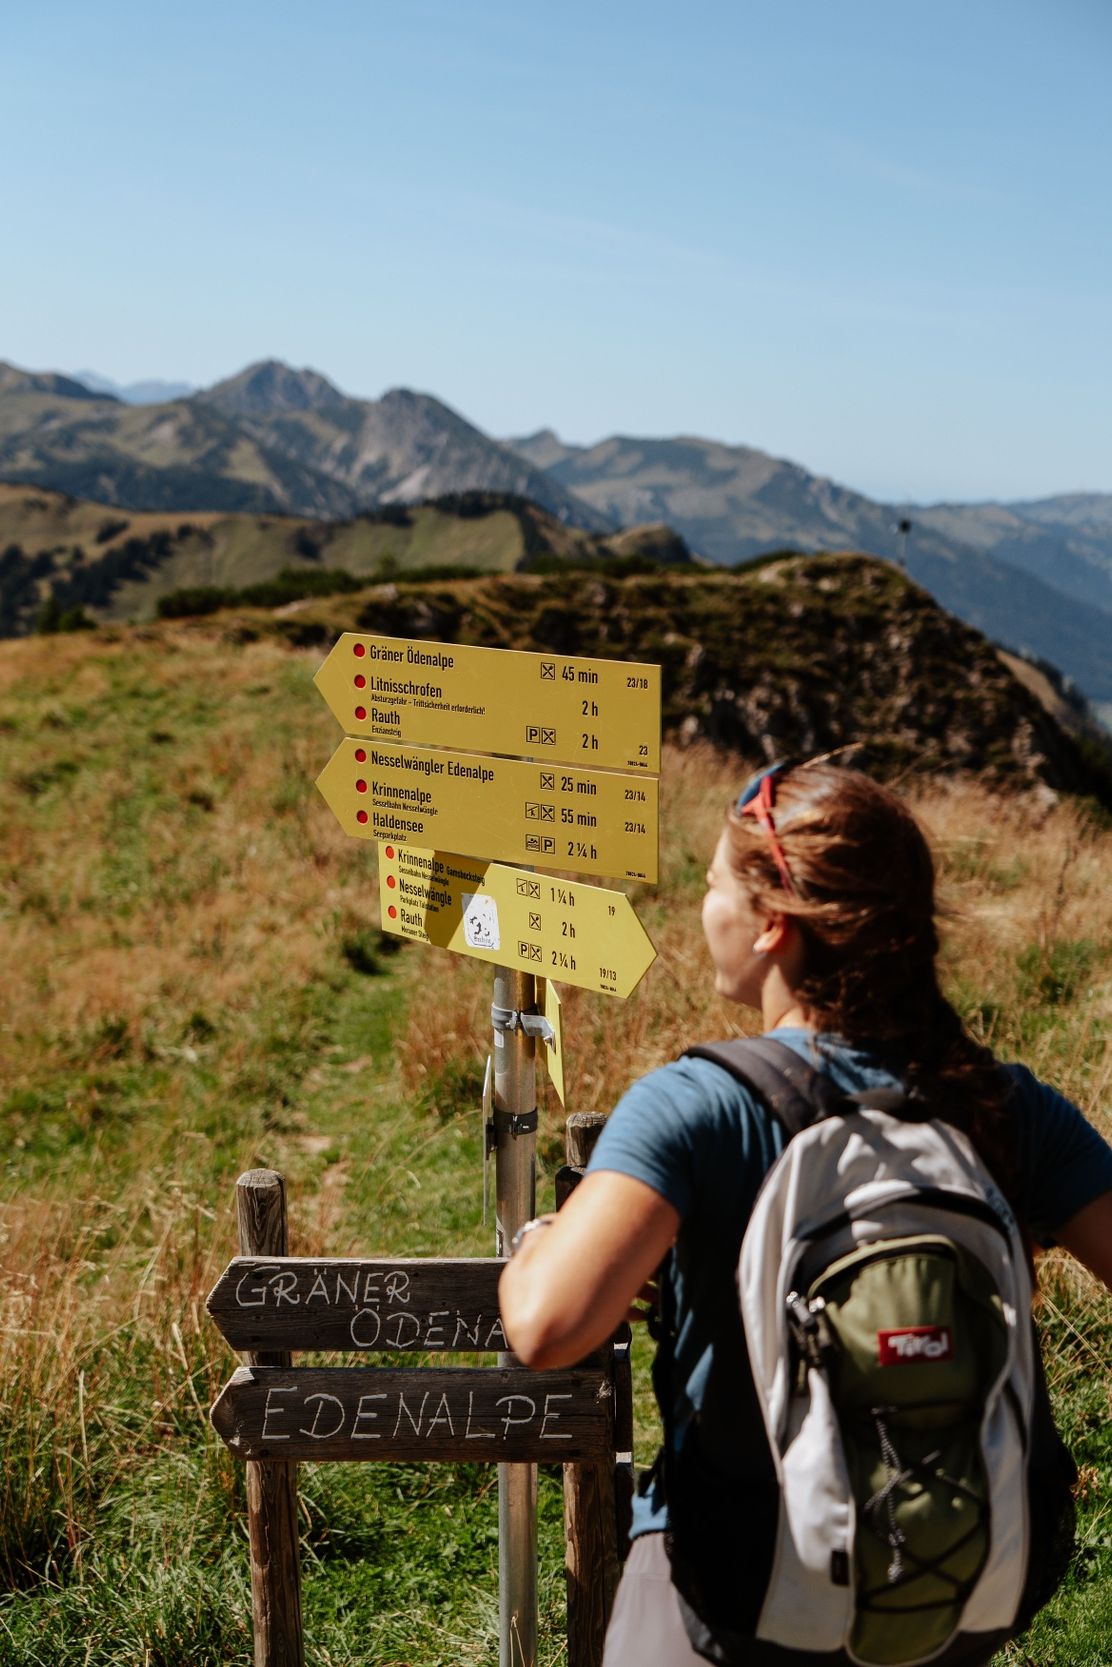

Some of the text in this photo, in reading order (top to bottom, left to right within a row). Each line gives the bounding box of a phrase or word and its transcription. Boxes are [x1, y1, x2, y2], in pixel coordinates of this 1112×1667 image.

[370, 645, 454, 671] Gräner Ödenalpe
[562, 666, 598, 684] 45 min
[627, 677, 648, 689] 23/18
[371, 676, 442, 698] Litnisschrofen
[371, 707, 400, 725] Rauth
[582, 700, 598, 716] 2 h
[582, 733, 598, 750] 2 h
[639, 745, 648, 756] 23
[371, 750, 494, 783] Nesselwängler Edenalpe
[372, 781, 432, 806] Krinnenalpe
[561, 776, 597, 795] 25 min
[624, 789, 646, 802] 23/14
[373, 812, 424, 833] Haldensee
[561, 808, 597, 827] 55 min
[624, 822, 646, 834] 23/14
[590, 844, 597, 860] h
[398, 848, 444, 875] Krinnenalpe
[399, 878, 452, 908] Nesselwängle
[569, 891, 575, 907] h
[400, 908, 423, 928] Rauth
[608, 905, 616, 917] 19
[562, 922, 576, 938] 2 h
[570, 955, 576, 971] h
[599, 967, 617, 981] 19/13
[235, 1266, 411, 1307] GRÄNER
[350, 1305, 509, 1348] ÖDENA
[888, 1331, 948, 1358] Tirol
[261, 1386, 573, 1441] EDENALPE
